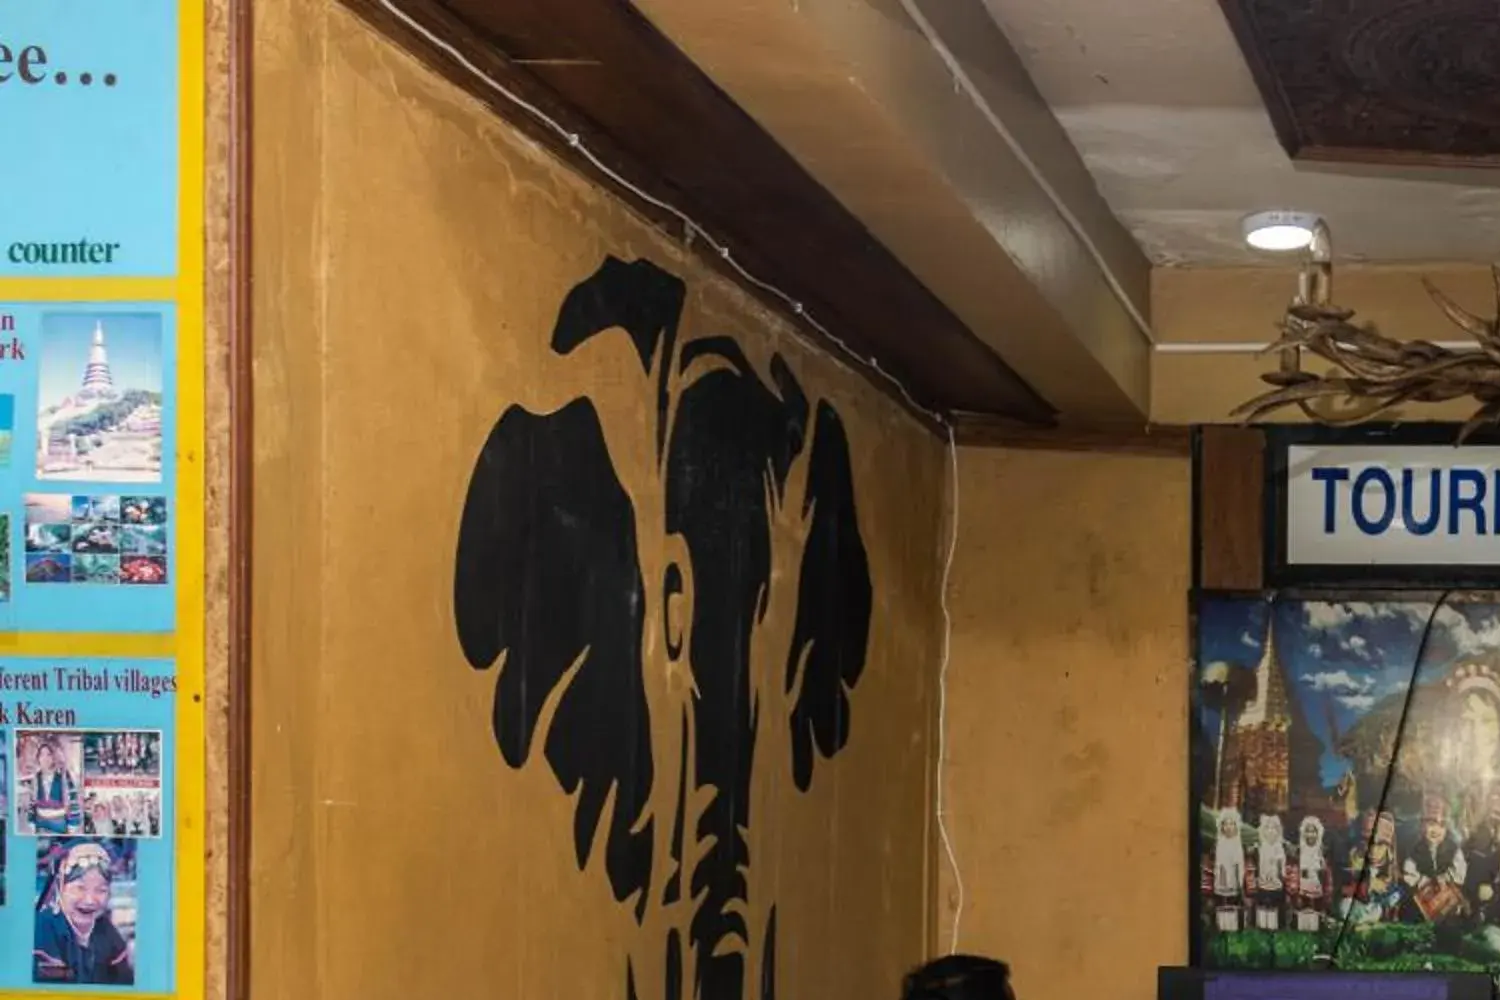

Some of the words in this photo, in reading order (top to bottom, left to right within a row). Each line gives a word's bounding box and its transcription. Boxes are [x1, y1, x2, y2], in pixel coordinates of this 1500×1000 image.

[8, 236, 120, 264] counter
[53, 667, 109, 692] Tribal
[113, 668, 177, 699] villages
[17, 701, 76, 726] Karen
